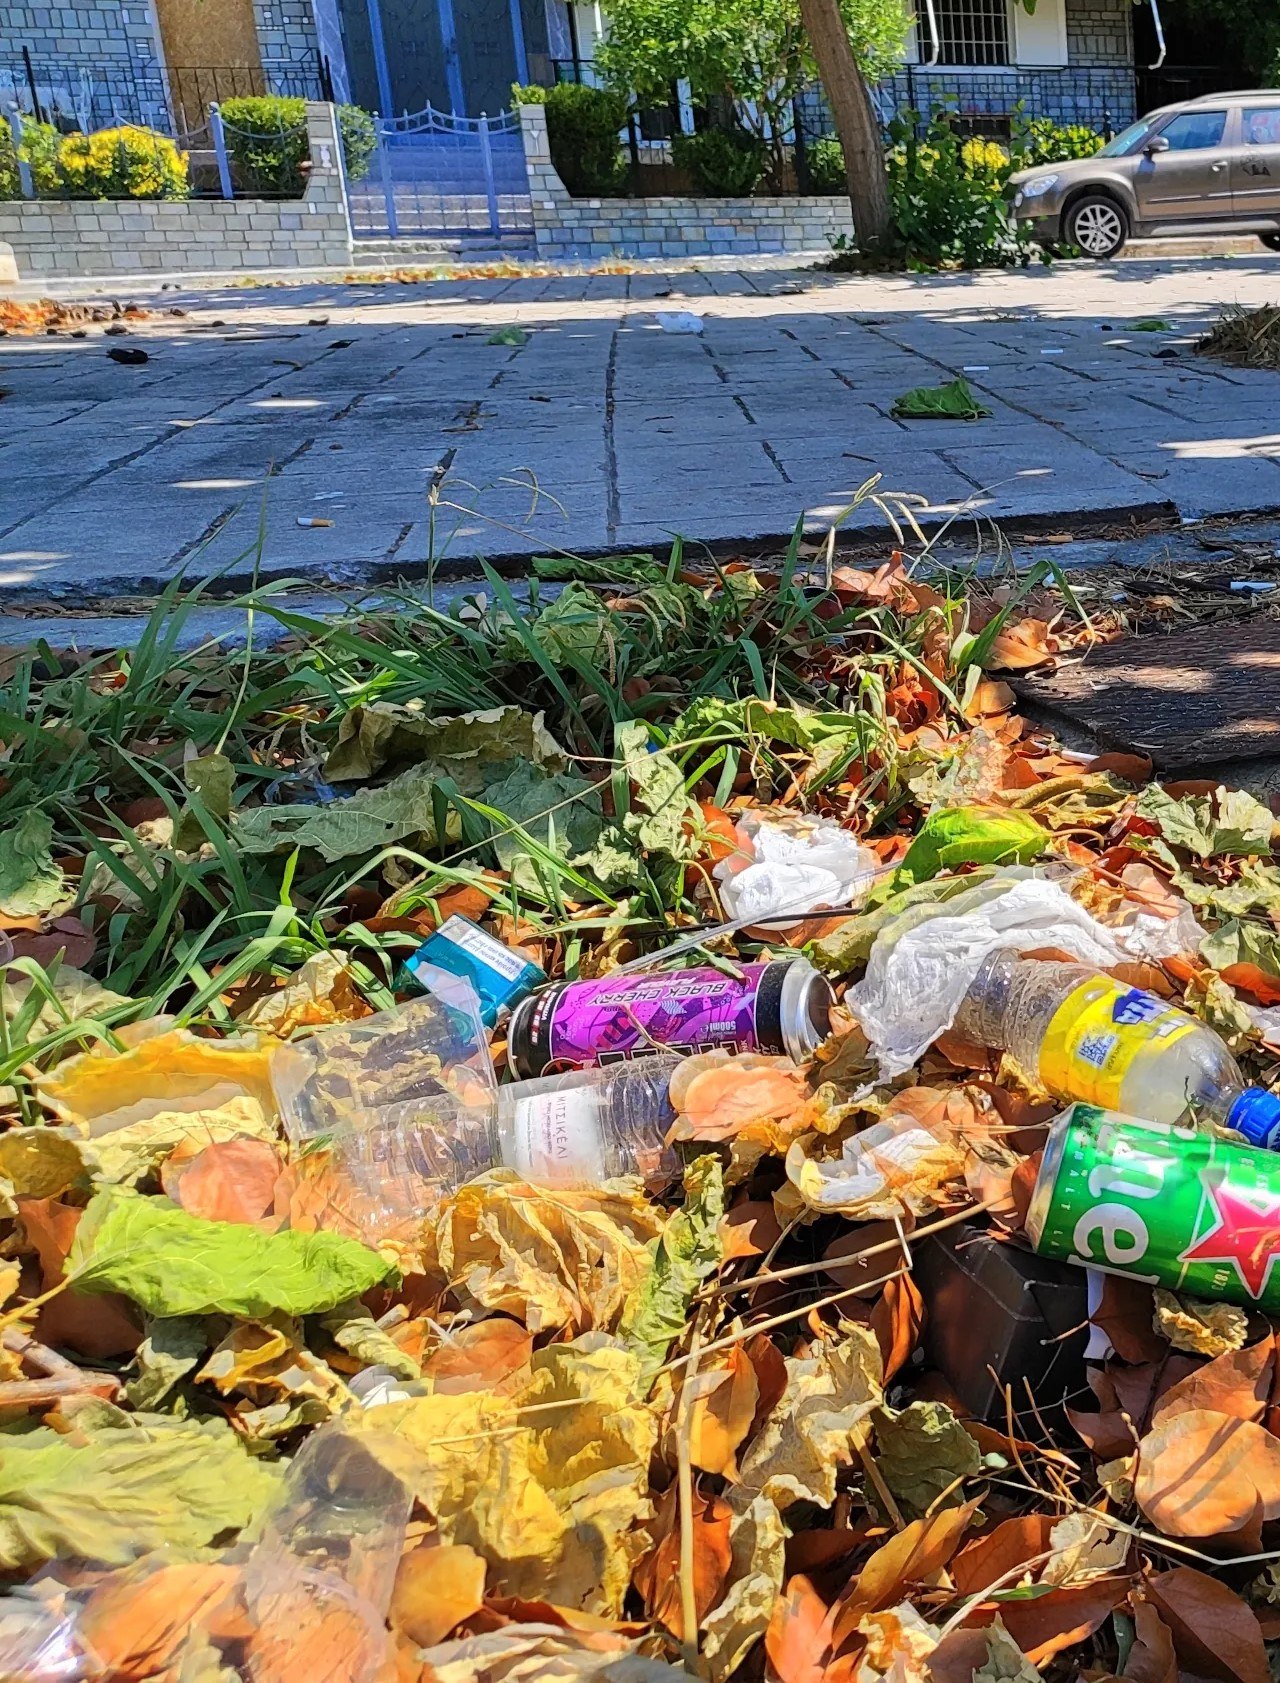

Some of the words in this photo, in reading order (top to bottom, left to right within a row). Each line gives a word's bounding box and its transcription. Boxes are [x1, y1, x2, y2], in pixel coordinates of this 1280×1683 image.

[585, 987, 660, 1006] CHERRY
[665, 982, 726, 997] BLACK
[708, 1019, 736, 1033] 500ml
